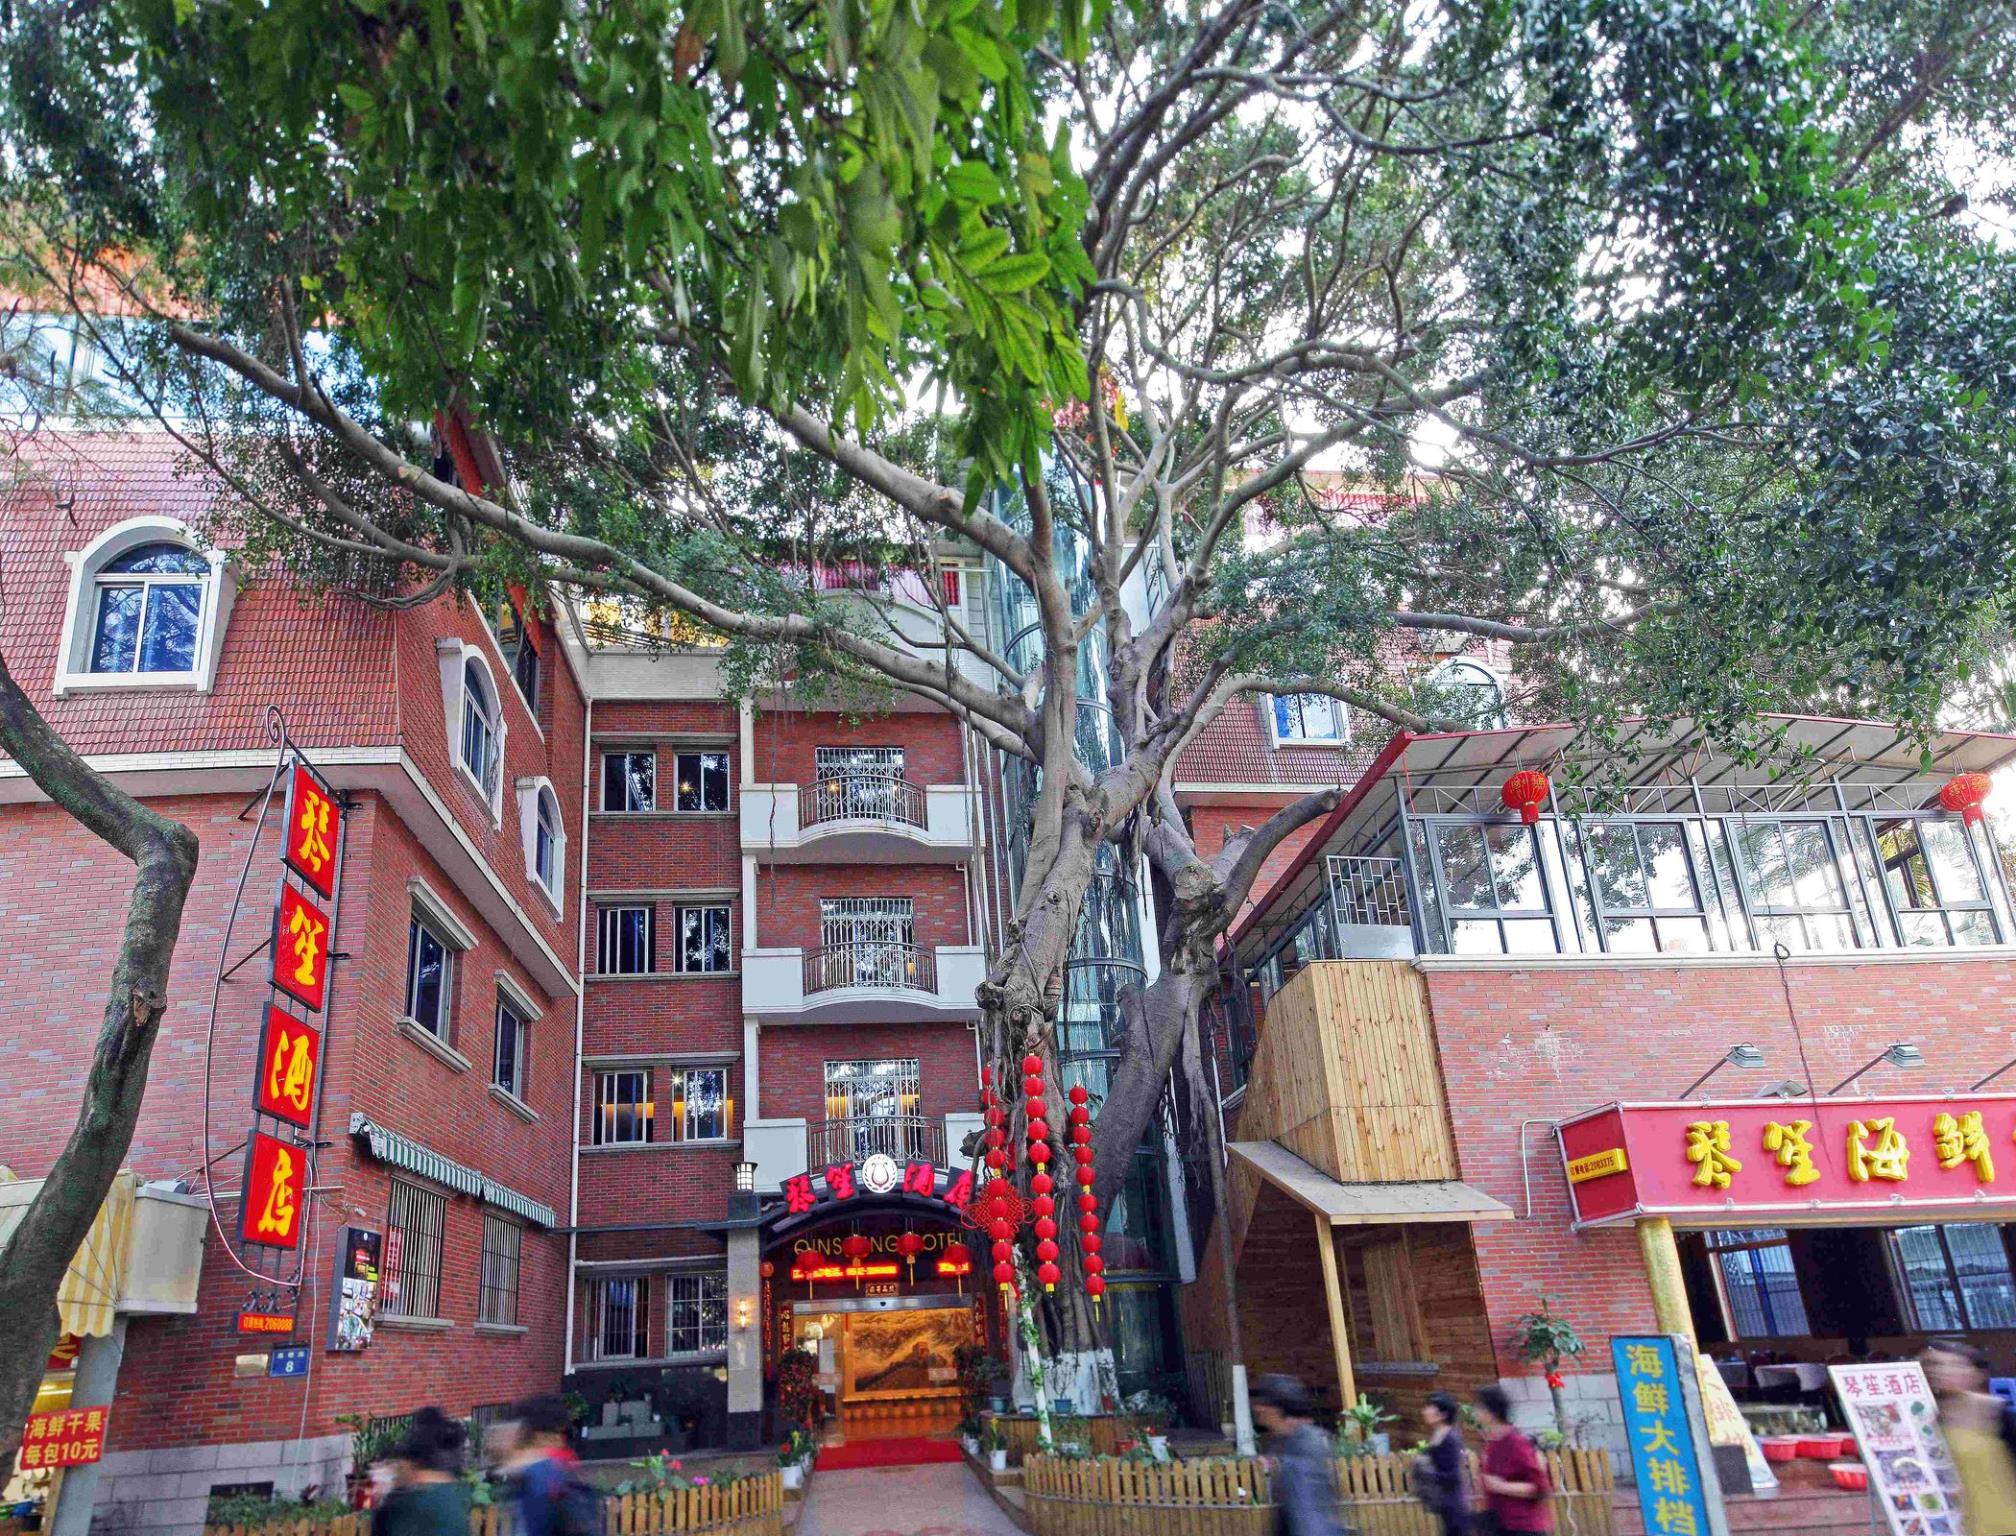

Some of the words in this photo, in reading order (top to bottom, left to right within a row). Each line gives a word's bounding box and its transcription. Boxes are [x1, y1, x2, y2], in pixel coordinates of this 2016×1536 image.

[257, 788, 332, 1237] 琴笙酒店
[1687, 1110, 2016, 1189] 琴笙海鲜
[794, 1235, 898, 1256] QINSNG
[285, 1360, 294, 1373] 8
[29, 1411, 102, 1440] 海鲜干果
[25, 1438, 98, 1466] 每包10元
